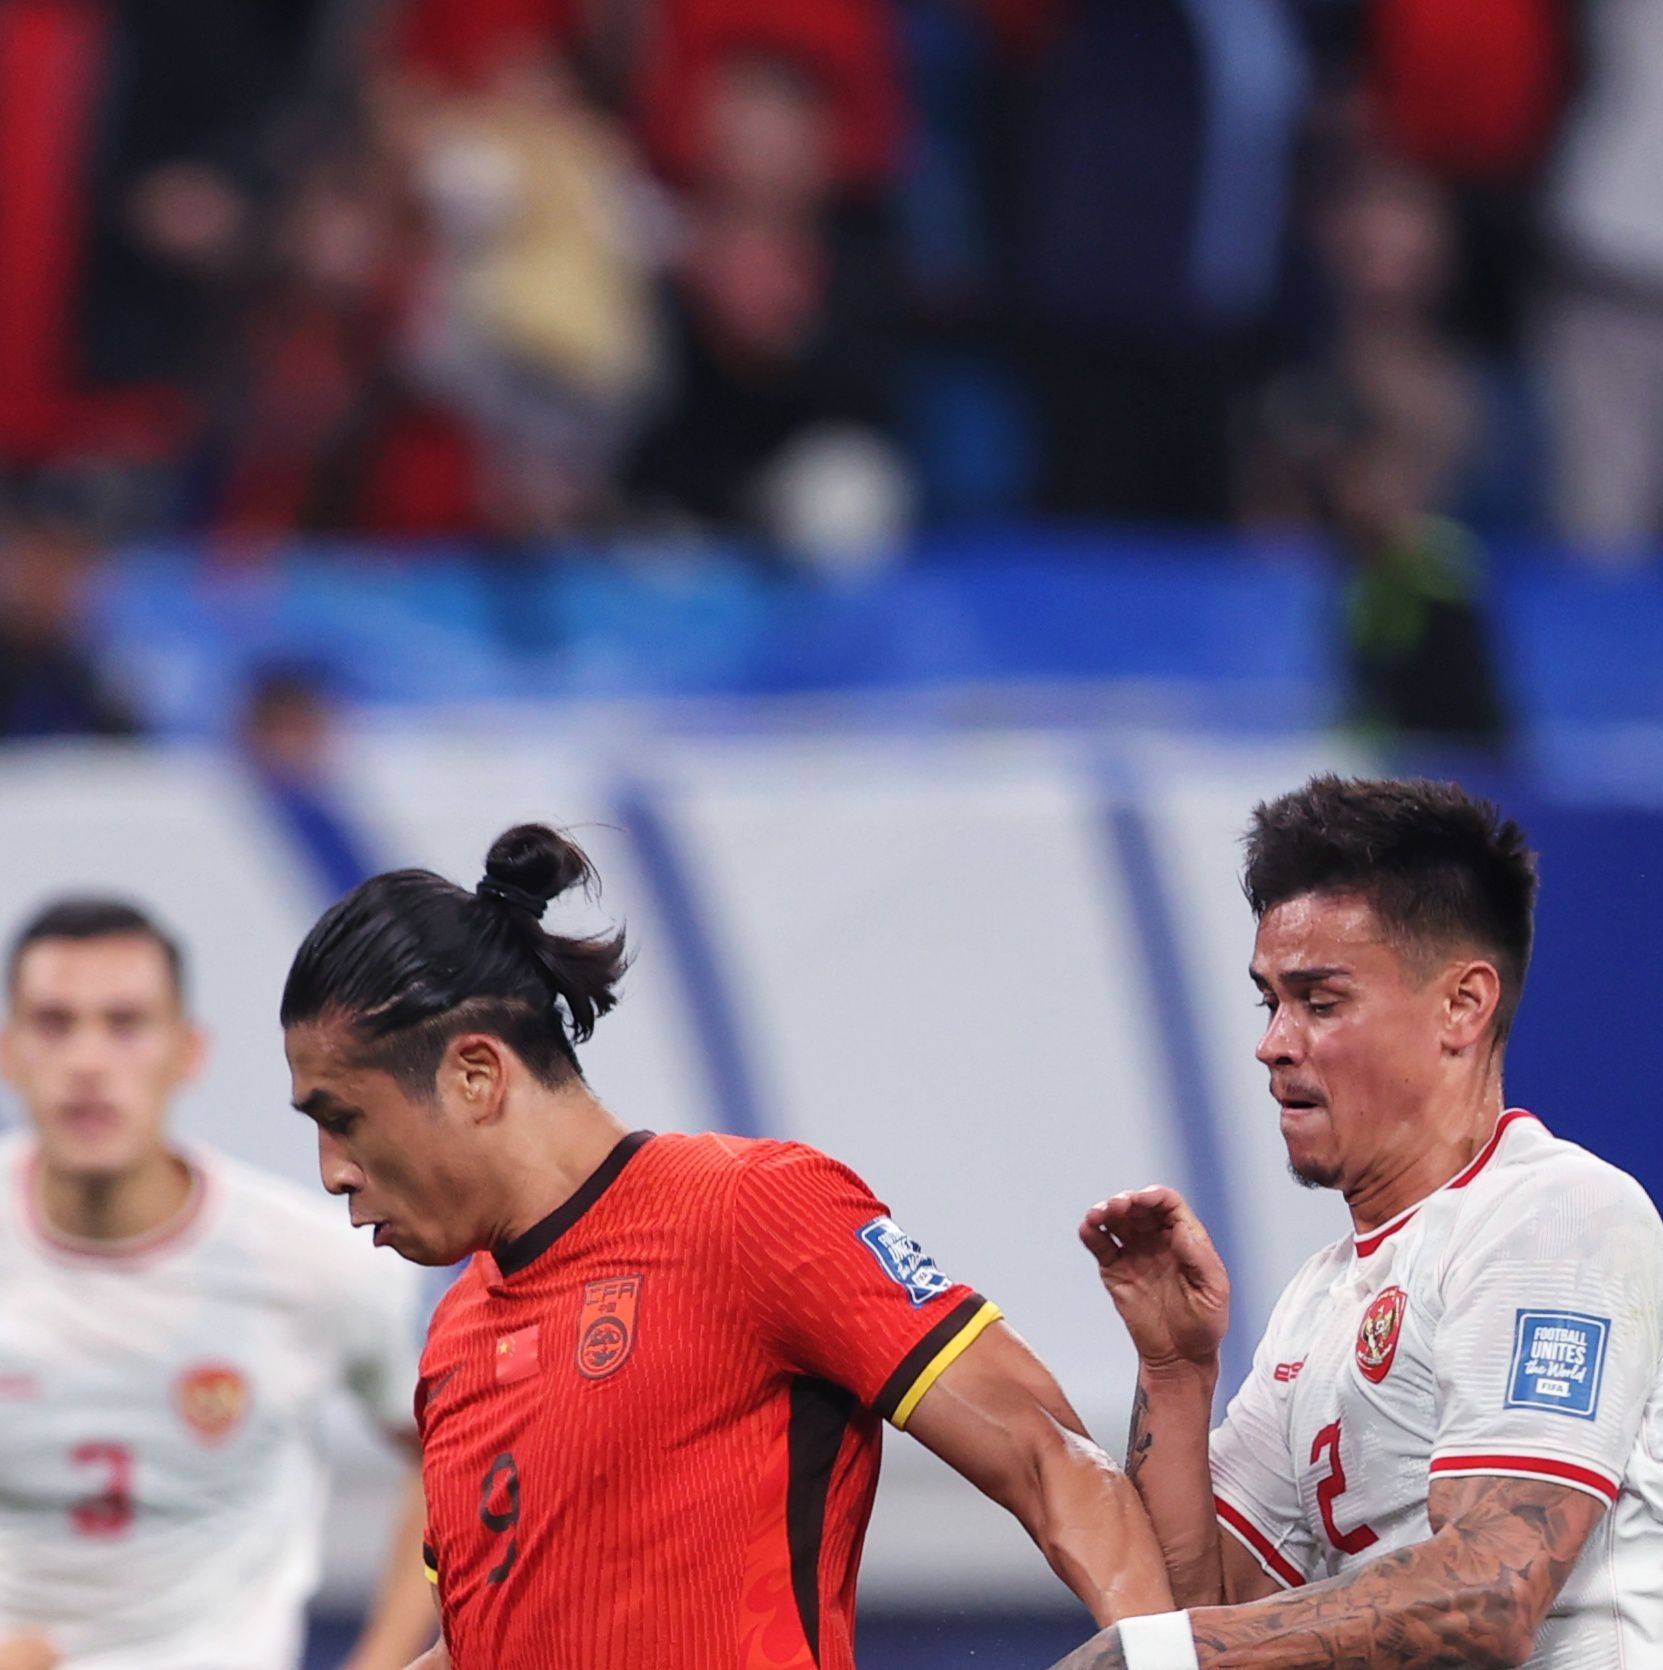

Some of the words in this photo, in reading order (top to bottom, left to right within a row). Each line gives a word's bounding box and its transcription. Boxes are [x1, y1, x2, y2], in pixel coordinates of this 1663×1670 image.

[1530, 1340, 1587, 1366] UNITES
[1533, 1326, 1588, 1347] FOOTBALL
[68, 1441, 135, 1540] 3
[479, 1451, 521, 1586] 9
[1309, 1418, 1380, 1556] 2
